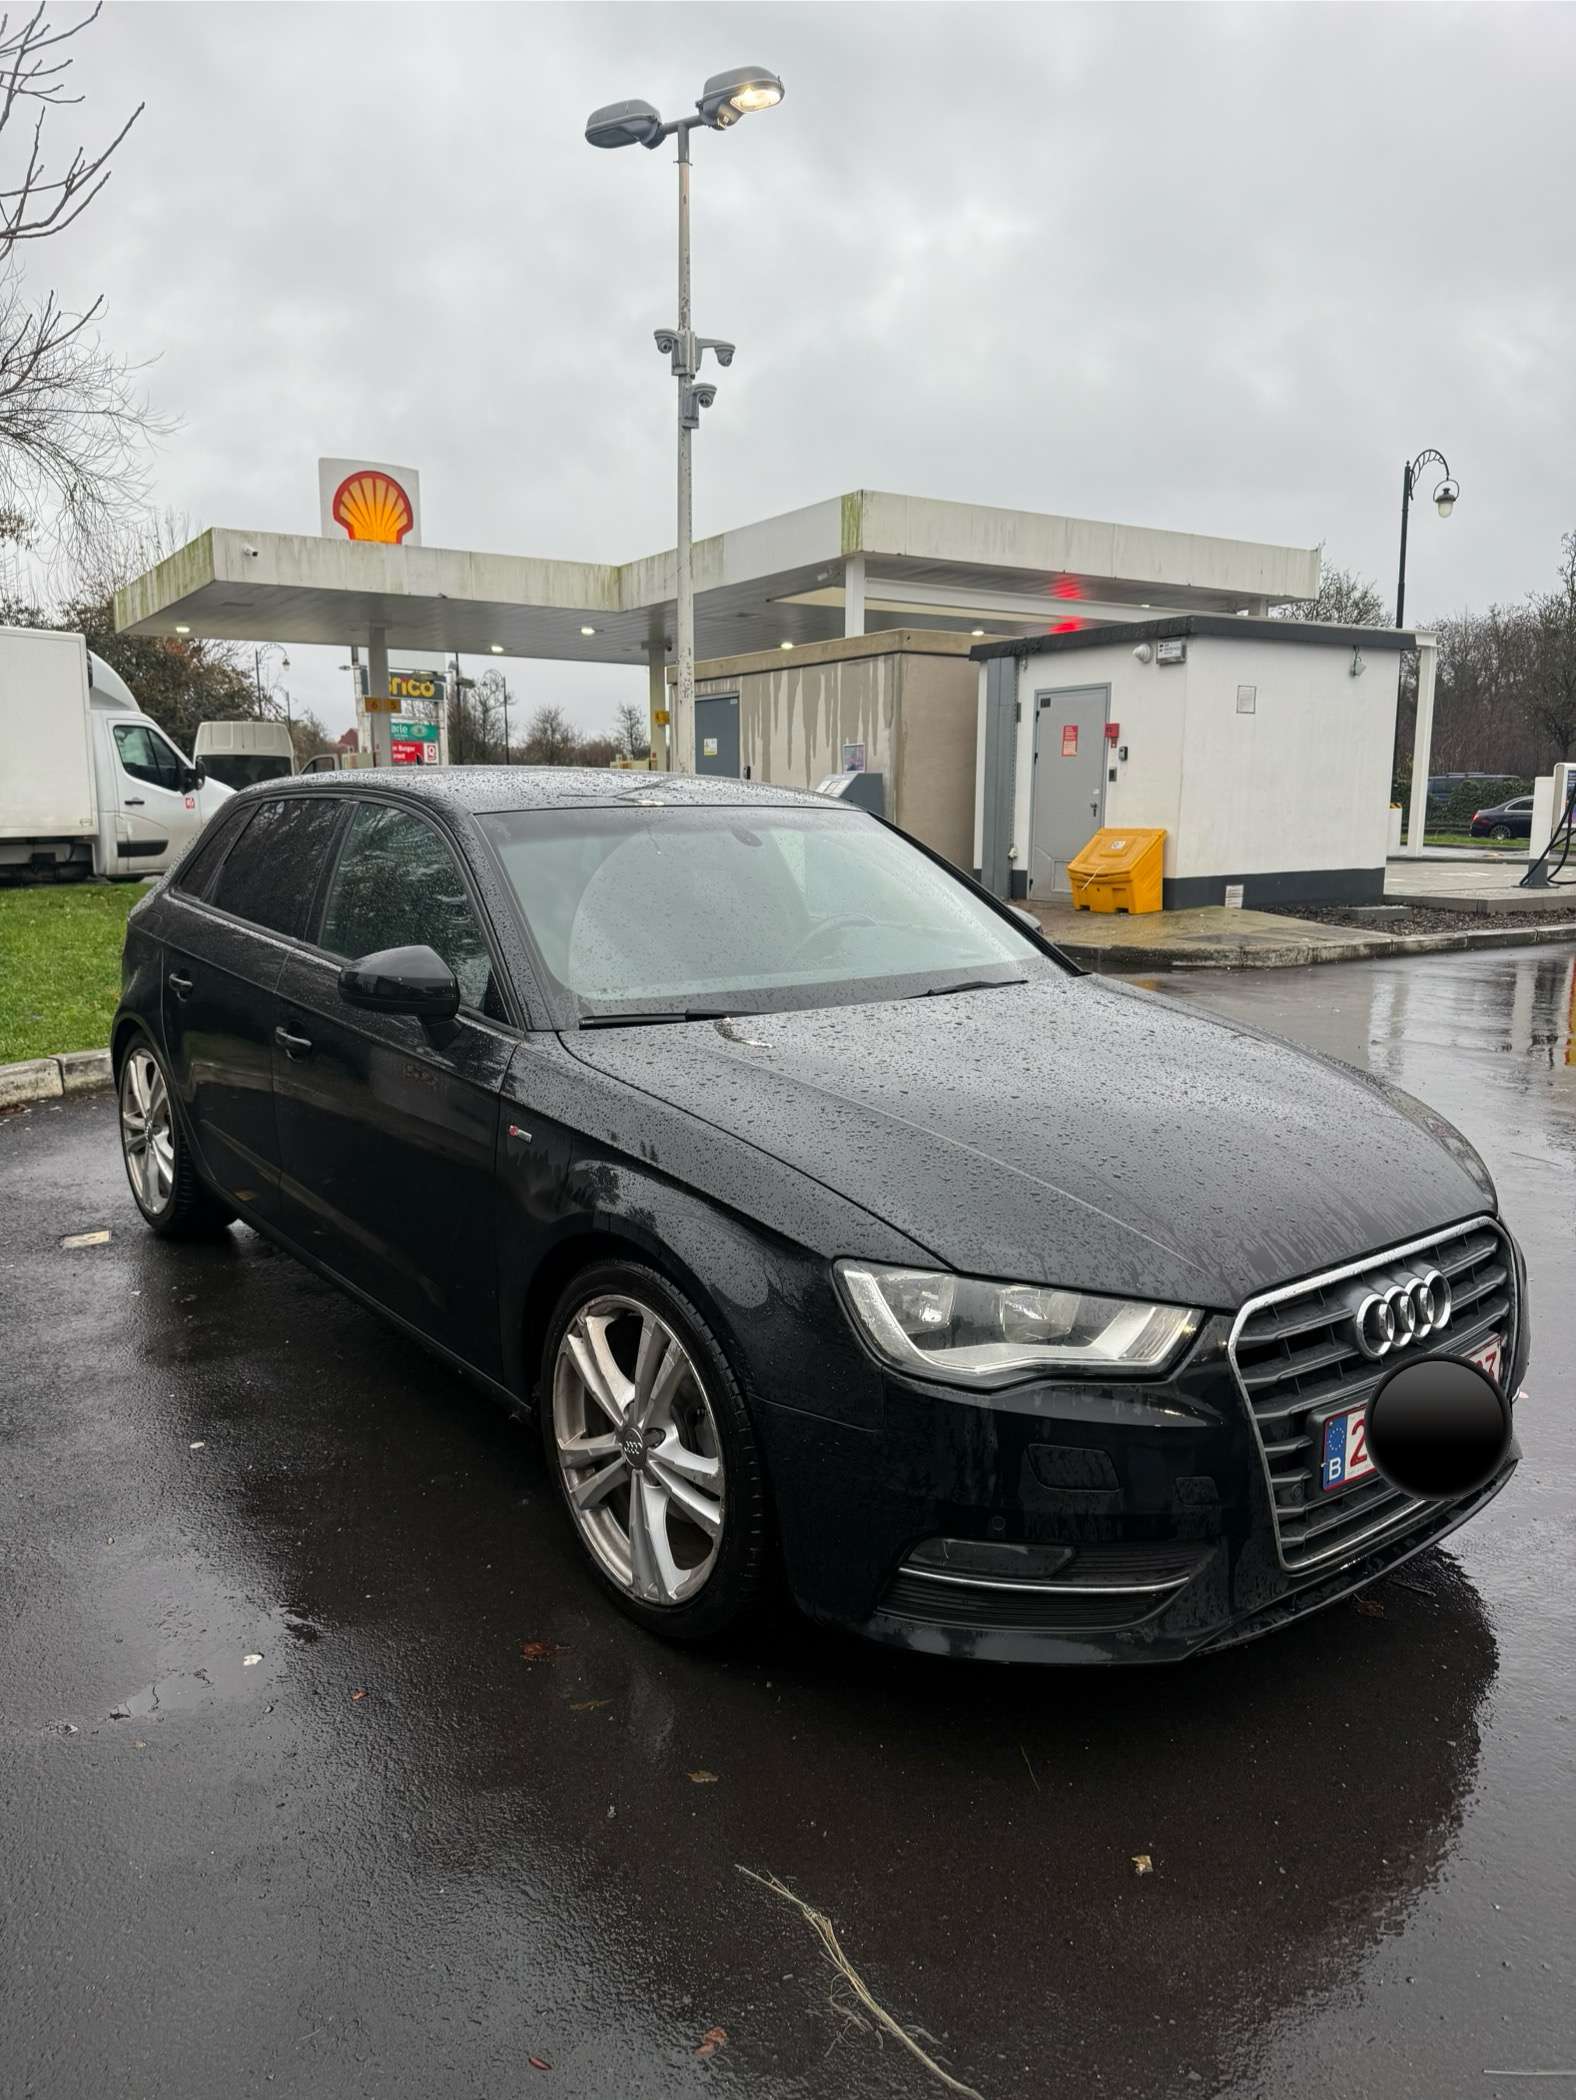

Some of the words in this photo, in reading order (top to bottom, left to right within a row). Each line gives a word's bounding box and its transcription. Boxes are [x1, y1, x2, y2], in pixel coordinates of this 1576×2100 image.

[388, 676, 434, 697] rico
[1350, 1418, 1367, 1467] 2
[1329, 1457, 1342, 1481] B
